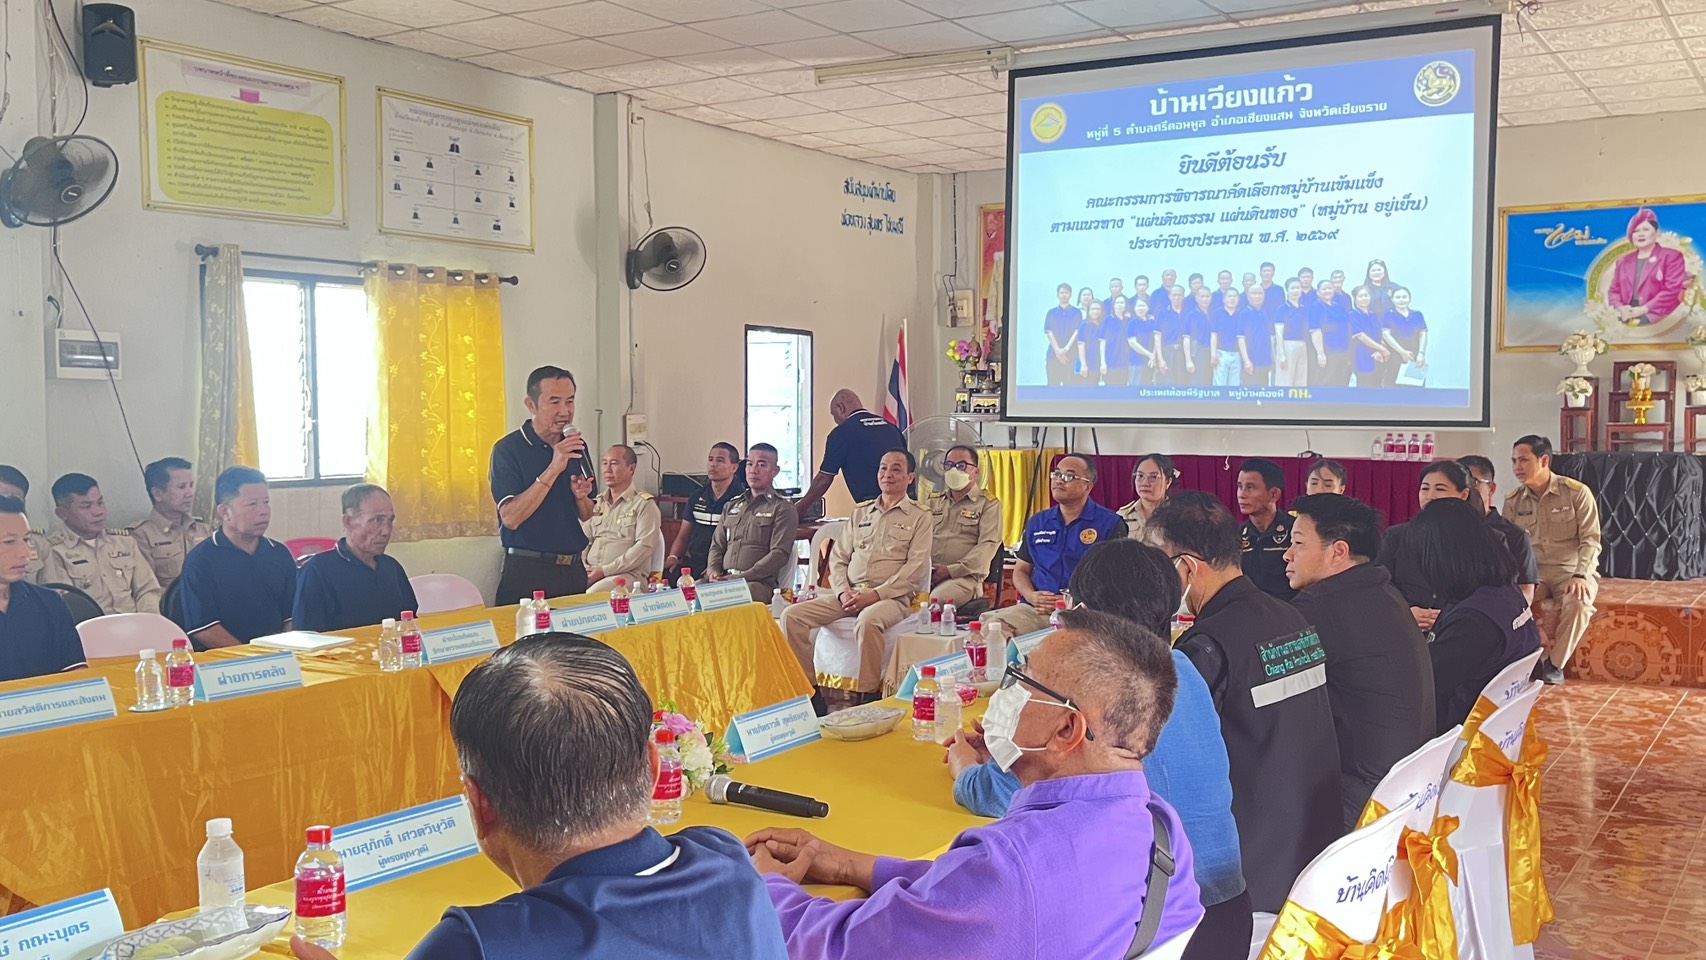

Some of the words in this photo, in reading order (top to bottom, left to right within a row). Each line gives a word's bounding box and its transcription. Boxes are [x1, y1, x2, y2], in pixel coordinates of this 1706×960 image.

[1149, 74, 1313, 117] บ้านเวียงแก้ว
[1086, 123, 1109, 141] หมู่ที่
[1113, 127, 1121, 136] 5
[1211, 109, 1294, 127] อำเภอเชียงแสน
[1298, 101, 1388, 119] จังหวัดเชียงราย
[1178, 145, 1287, 175] ยินดีต้อนรับ
[1085, 170, 1384, 209] คณะกรรมการพิจารณาคัดเลือกหมู่บ้านเข้มแข็ง
[1049, 216, 1125, 233] ตามแนวทาง
[1311, 198, 1369, 220] (หมู่บ้าน
[1374, 193, 1429, 217] อยู่เย็น)
[1128, 232, 1253, 250] ประจำปีงบประมาณ
[1258, 229, 1289, 243] พ.ศ.
[1295, 228, 1340, 242] ๒๕๖๙
[561, 612, 607, 628] ฝ่ายปกครอง
[217, 665, 287, 686] ฝ่ายการคลัง
[0, 694, 107, 718] ายสวัสดิการและสังคม
[338, 830, 394, 859] นายสุภักดิ์
[378, 844, 430, 868] ผู้ทรงคุณวุฒิ
